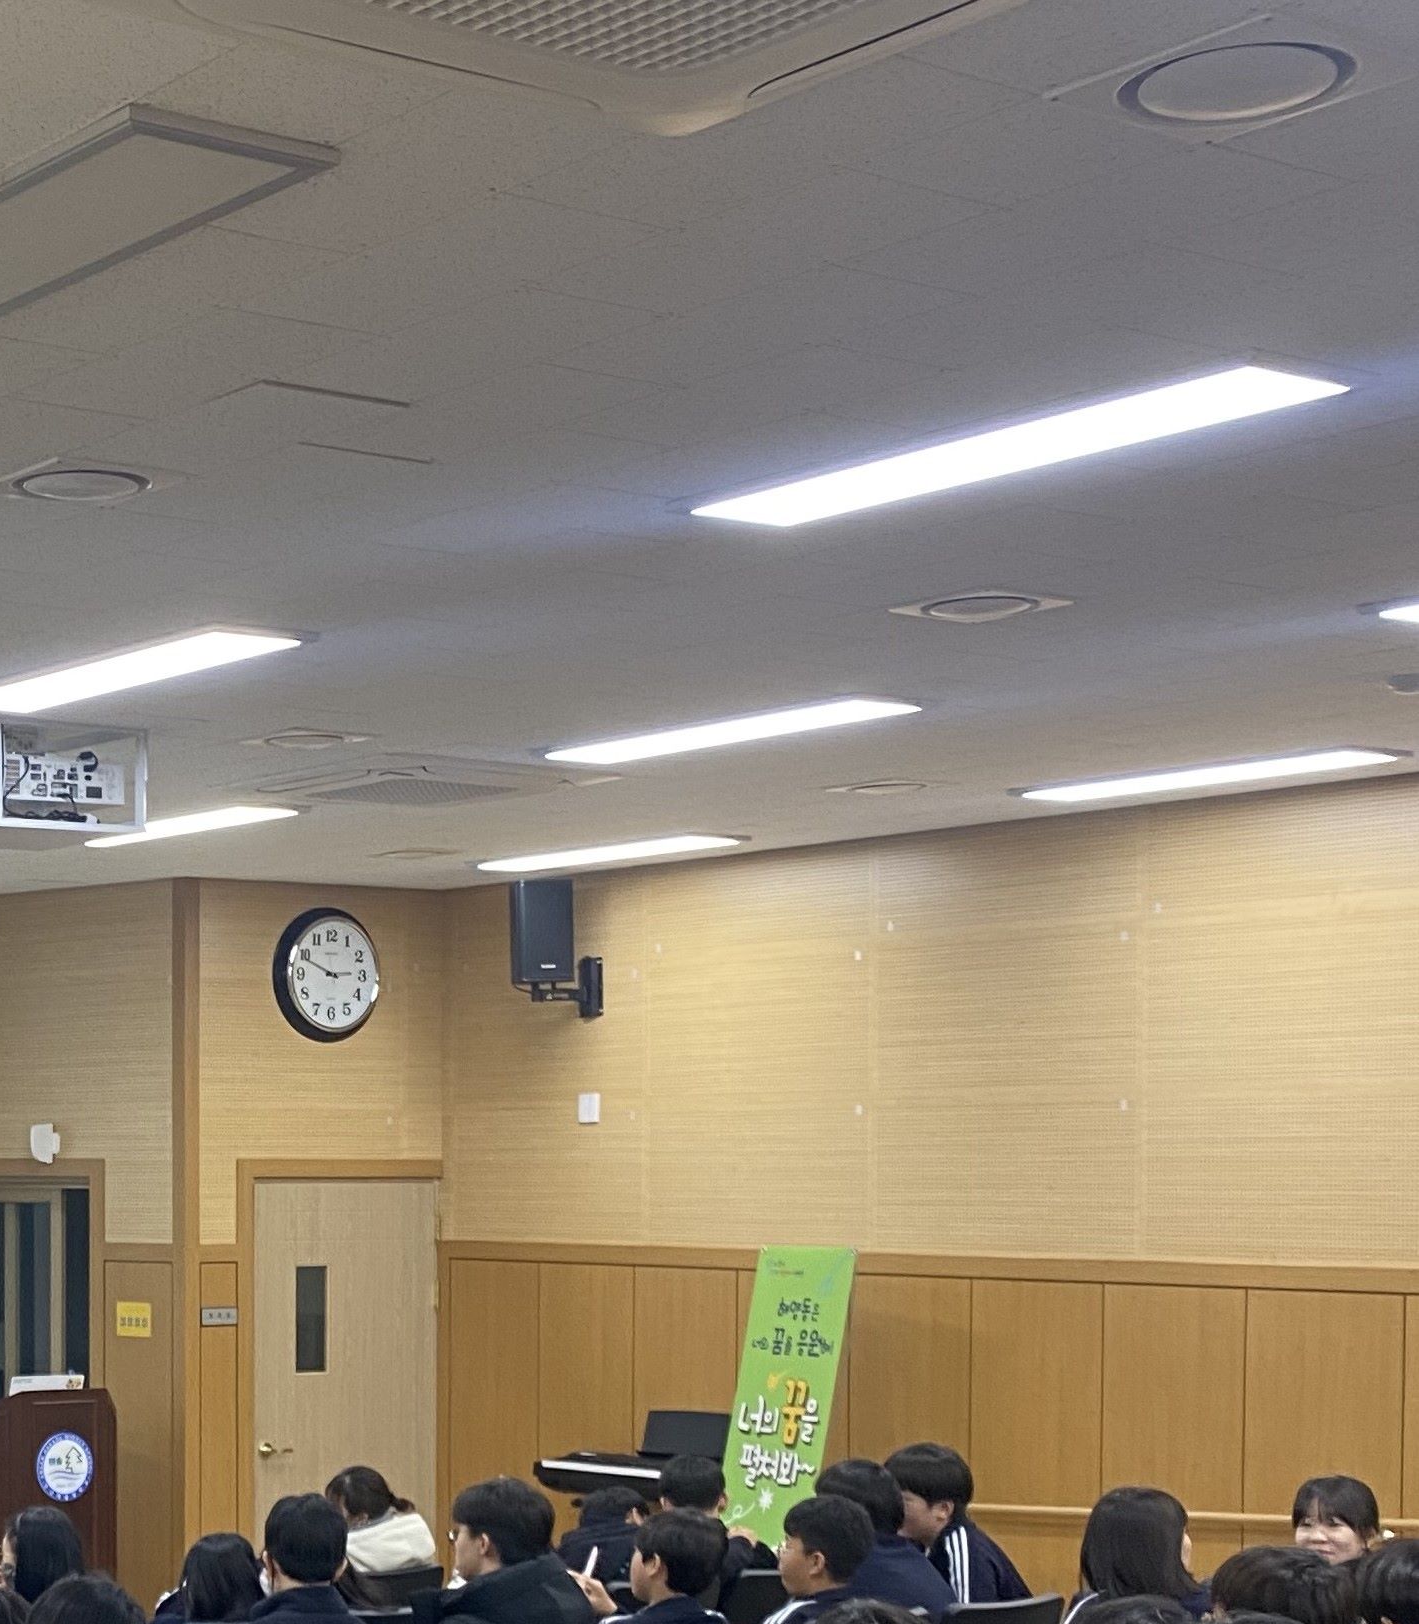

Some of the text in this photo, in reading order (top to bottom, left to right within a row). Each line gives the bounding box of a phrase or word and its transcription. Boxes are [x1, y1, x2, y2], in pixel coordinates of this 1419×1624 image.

[312, 933, 321, 946] 11
[326, 929, 338, 943] 12
[344, 935, 350, 948] 1
[300, 948, 311, 961] 10
[354, 950, 364, 963] 2
[296, 967, 305, 981] 9
[357, 969, 367, 983] 3
[300, 986, 310, 1000] 8
[352, 988, 361, 1001] 4
[312, 1002, 321, 1016] 7
[327, 1006, 336, 1020] 6
[342, 1002, 352, 1016] 5
[771, 1327, 793, 1356] 꿈을
[737, 1378, 820, 1446] 너의 꿈을
[739, 1443, 817, 1489] 펼쳐봐~
